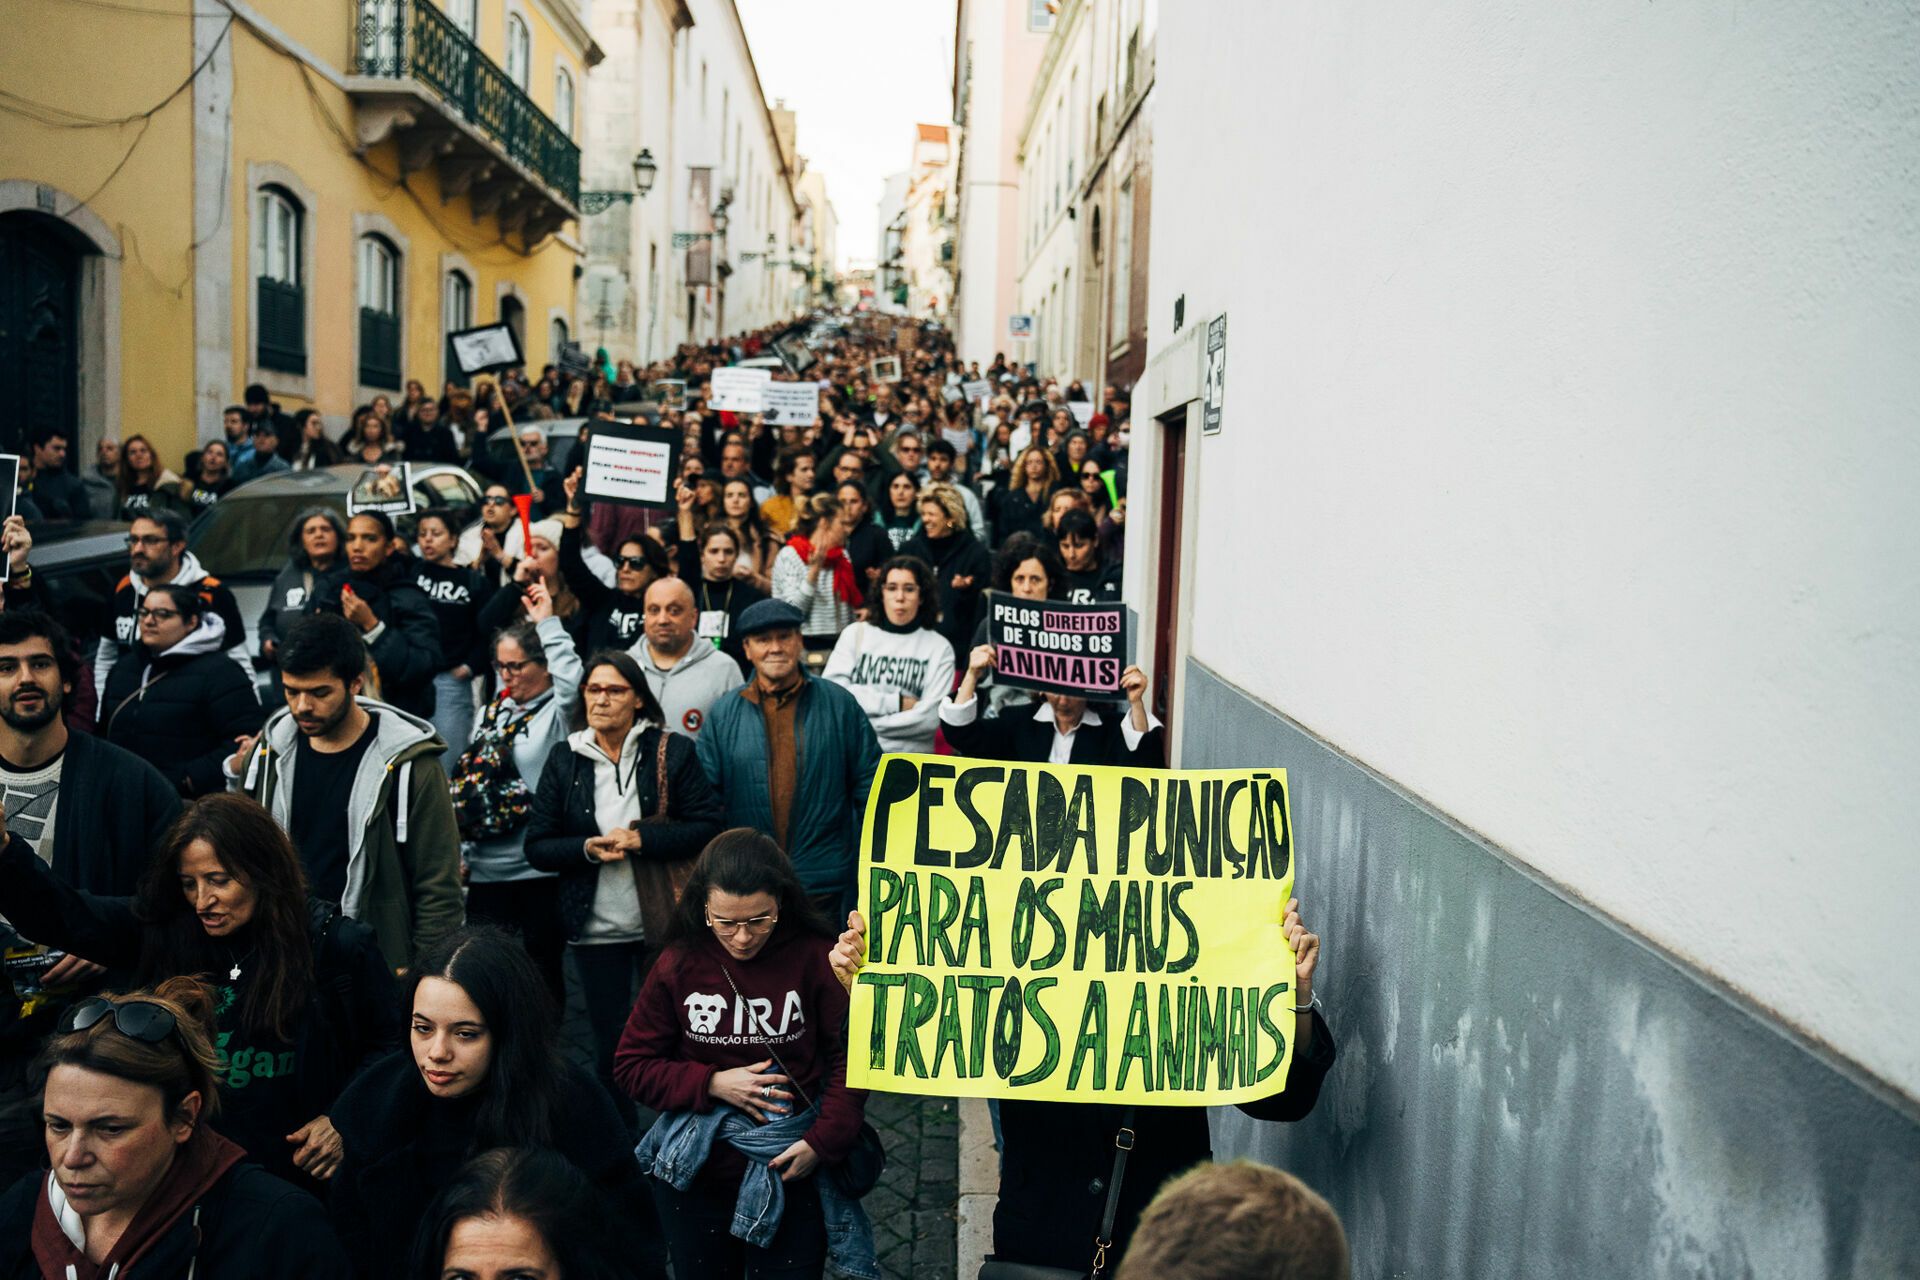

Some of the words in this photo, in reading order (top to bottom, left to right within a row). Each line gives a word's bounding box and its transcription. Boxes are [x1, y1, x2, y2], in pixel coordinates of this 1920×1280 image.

[994, 604, 1040, 627] PELOS
[1045, 613, 1118, 632] DIREITOS
[1003, 626, 1023, 645] DE
[1028, 630, 1083, 652] TODOS
[1089, 635, 1113, 653] OS
[1000, 648, 1116, 686] ANIMAIS
[870, 758, 1099, 874] PESADA
[1116, 773, 1290, 880] PUNIÇÃO
[868, 867, 991, 968] PARA
[1011, 876, 1066, 970] OS
[1073, 878, 1200, 973] MAUS
[733, 989, 805, 1036] IRA
[857, 972, 1061, 1087] TRATOS
[1066, 979, 1107, 1092] A
[1115, 975, 1289, 1092] ANIMAIS
[685, 1030, 741, 1045] INTERVENÇÃO
[742, 1036, 749, 1044] E
[213, 1046, 296, 1088] egan
